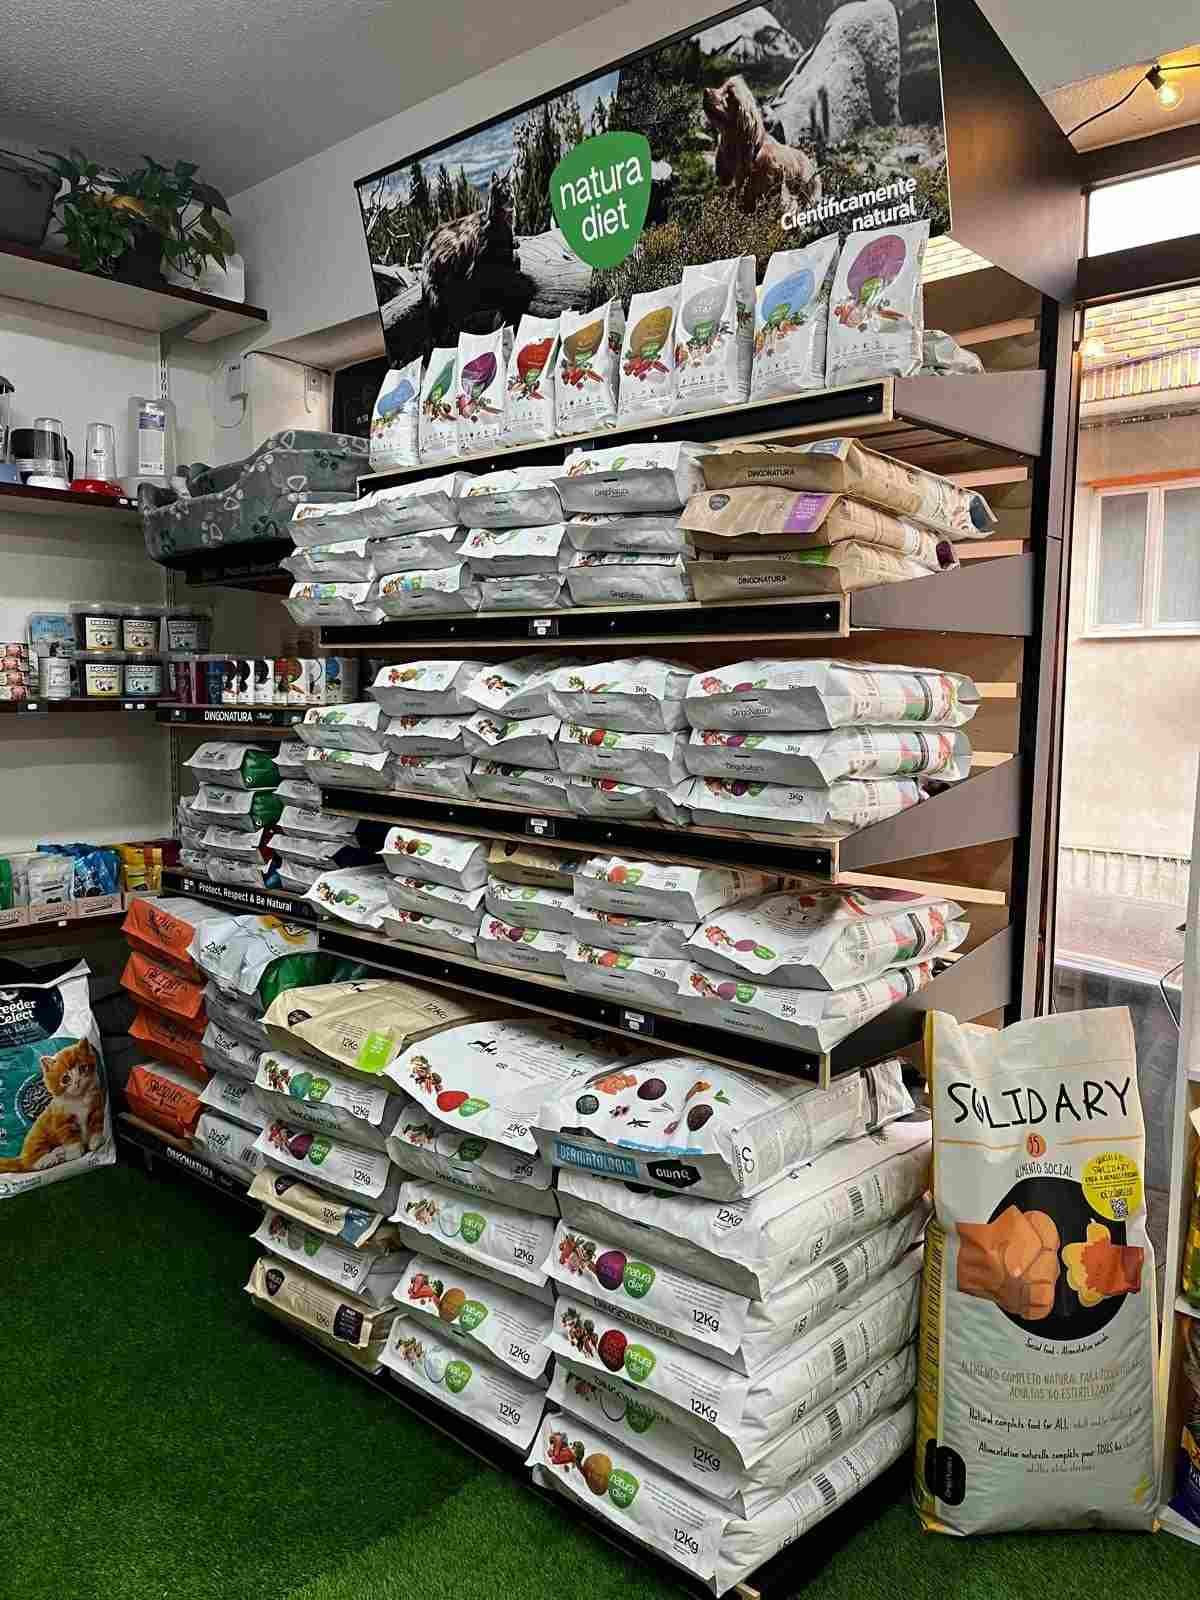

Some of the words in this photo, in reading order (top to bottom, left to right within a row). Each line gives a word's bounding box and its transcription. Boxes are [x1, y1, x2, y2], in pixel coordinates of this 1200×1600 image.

[559, 155, 644, 211] natura
[581, 199, 630, 242] diet
[852, 198, 917, 232] natural
[204, 711, 253, 722] DINGONATURA
[266, 897, 293, 913] Natural
[353, 1169, 371, 1185] 12Kg
[1044, 1162, 1072, 1176] SOCIAL
[716, 1208, 743, 1227] 12Kg
[514, 1247, 534, 1264] 12Kg
[343, 1262, 359, 1279] 12Kg
[692, 1309, 720, 1332] 12Kg
[508, 1344, 531, 1364] 12Kg
[499, 1403, 521, 1425] 12Kg
[691, 1399, 718, 1423] 12Kg
[969, 1407, 993, 1424] Natural
[994, 1418, 1025, 1432] complete
[1027, 1419, 1042, 1430] food
[1043, 1419, 1052, 1430] for
[692, 1446, 721, 1471] 12Kg
[671, 1528, 699, 1554] 12Kg
